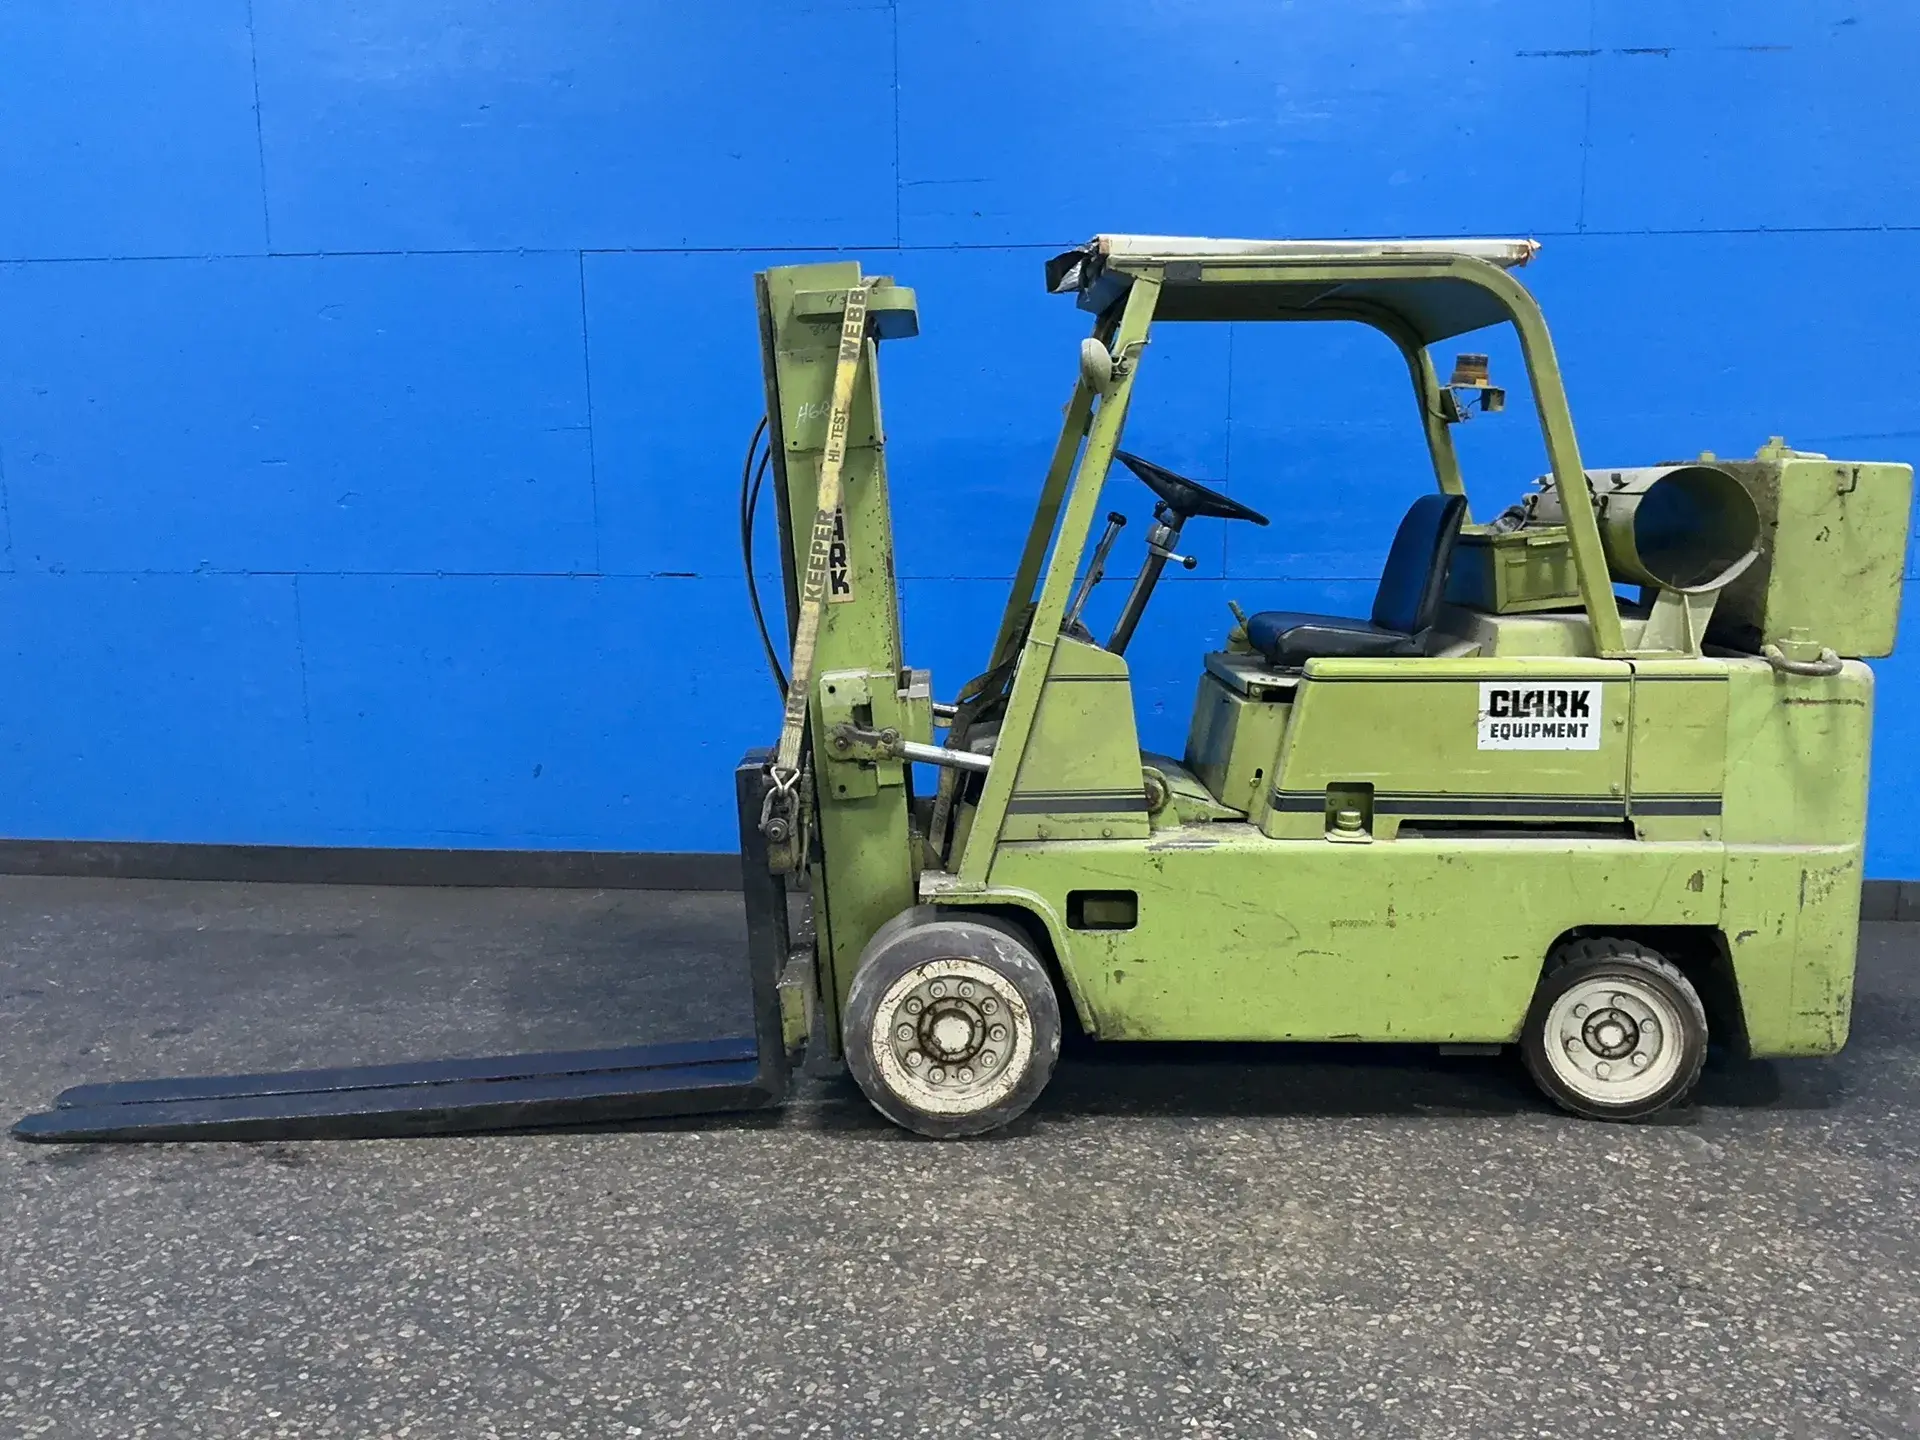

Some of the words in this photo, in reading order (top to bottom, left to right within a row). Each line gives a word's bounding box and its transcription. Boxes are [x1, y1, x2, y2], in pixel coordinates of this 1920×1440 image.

[840, 289, 867, 361] WEBB
[804, 509, 835, 602] KEEPER
[1489, 690, 1590, 718] CLARK
[1490, 723, 1589, 740] EQUIPMENT
